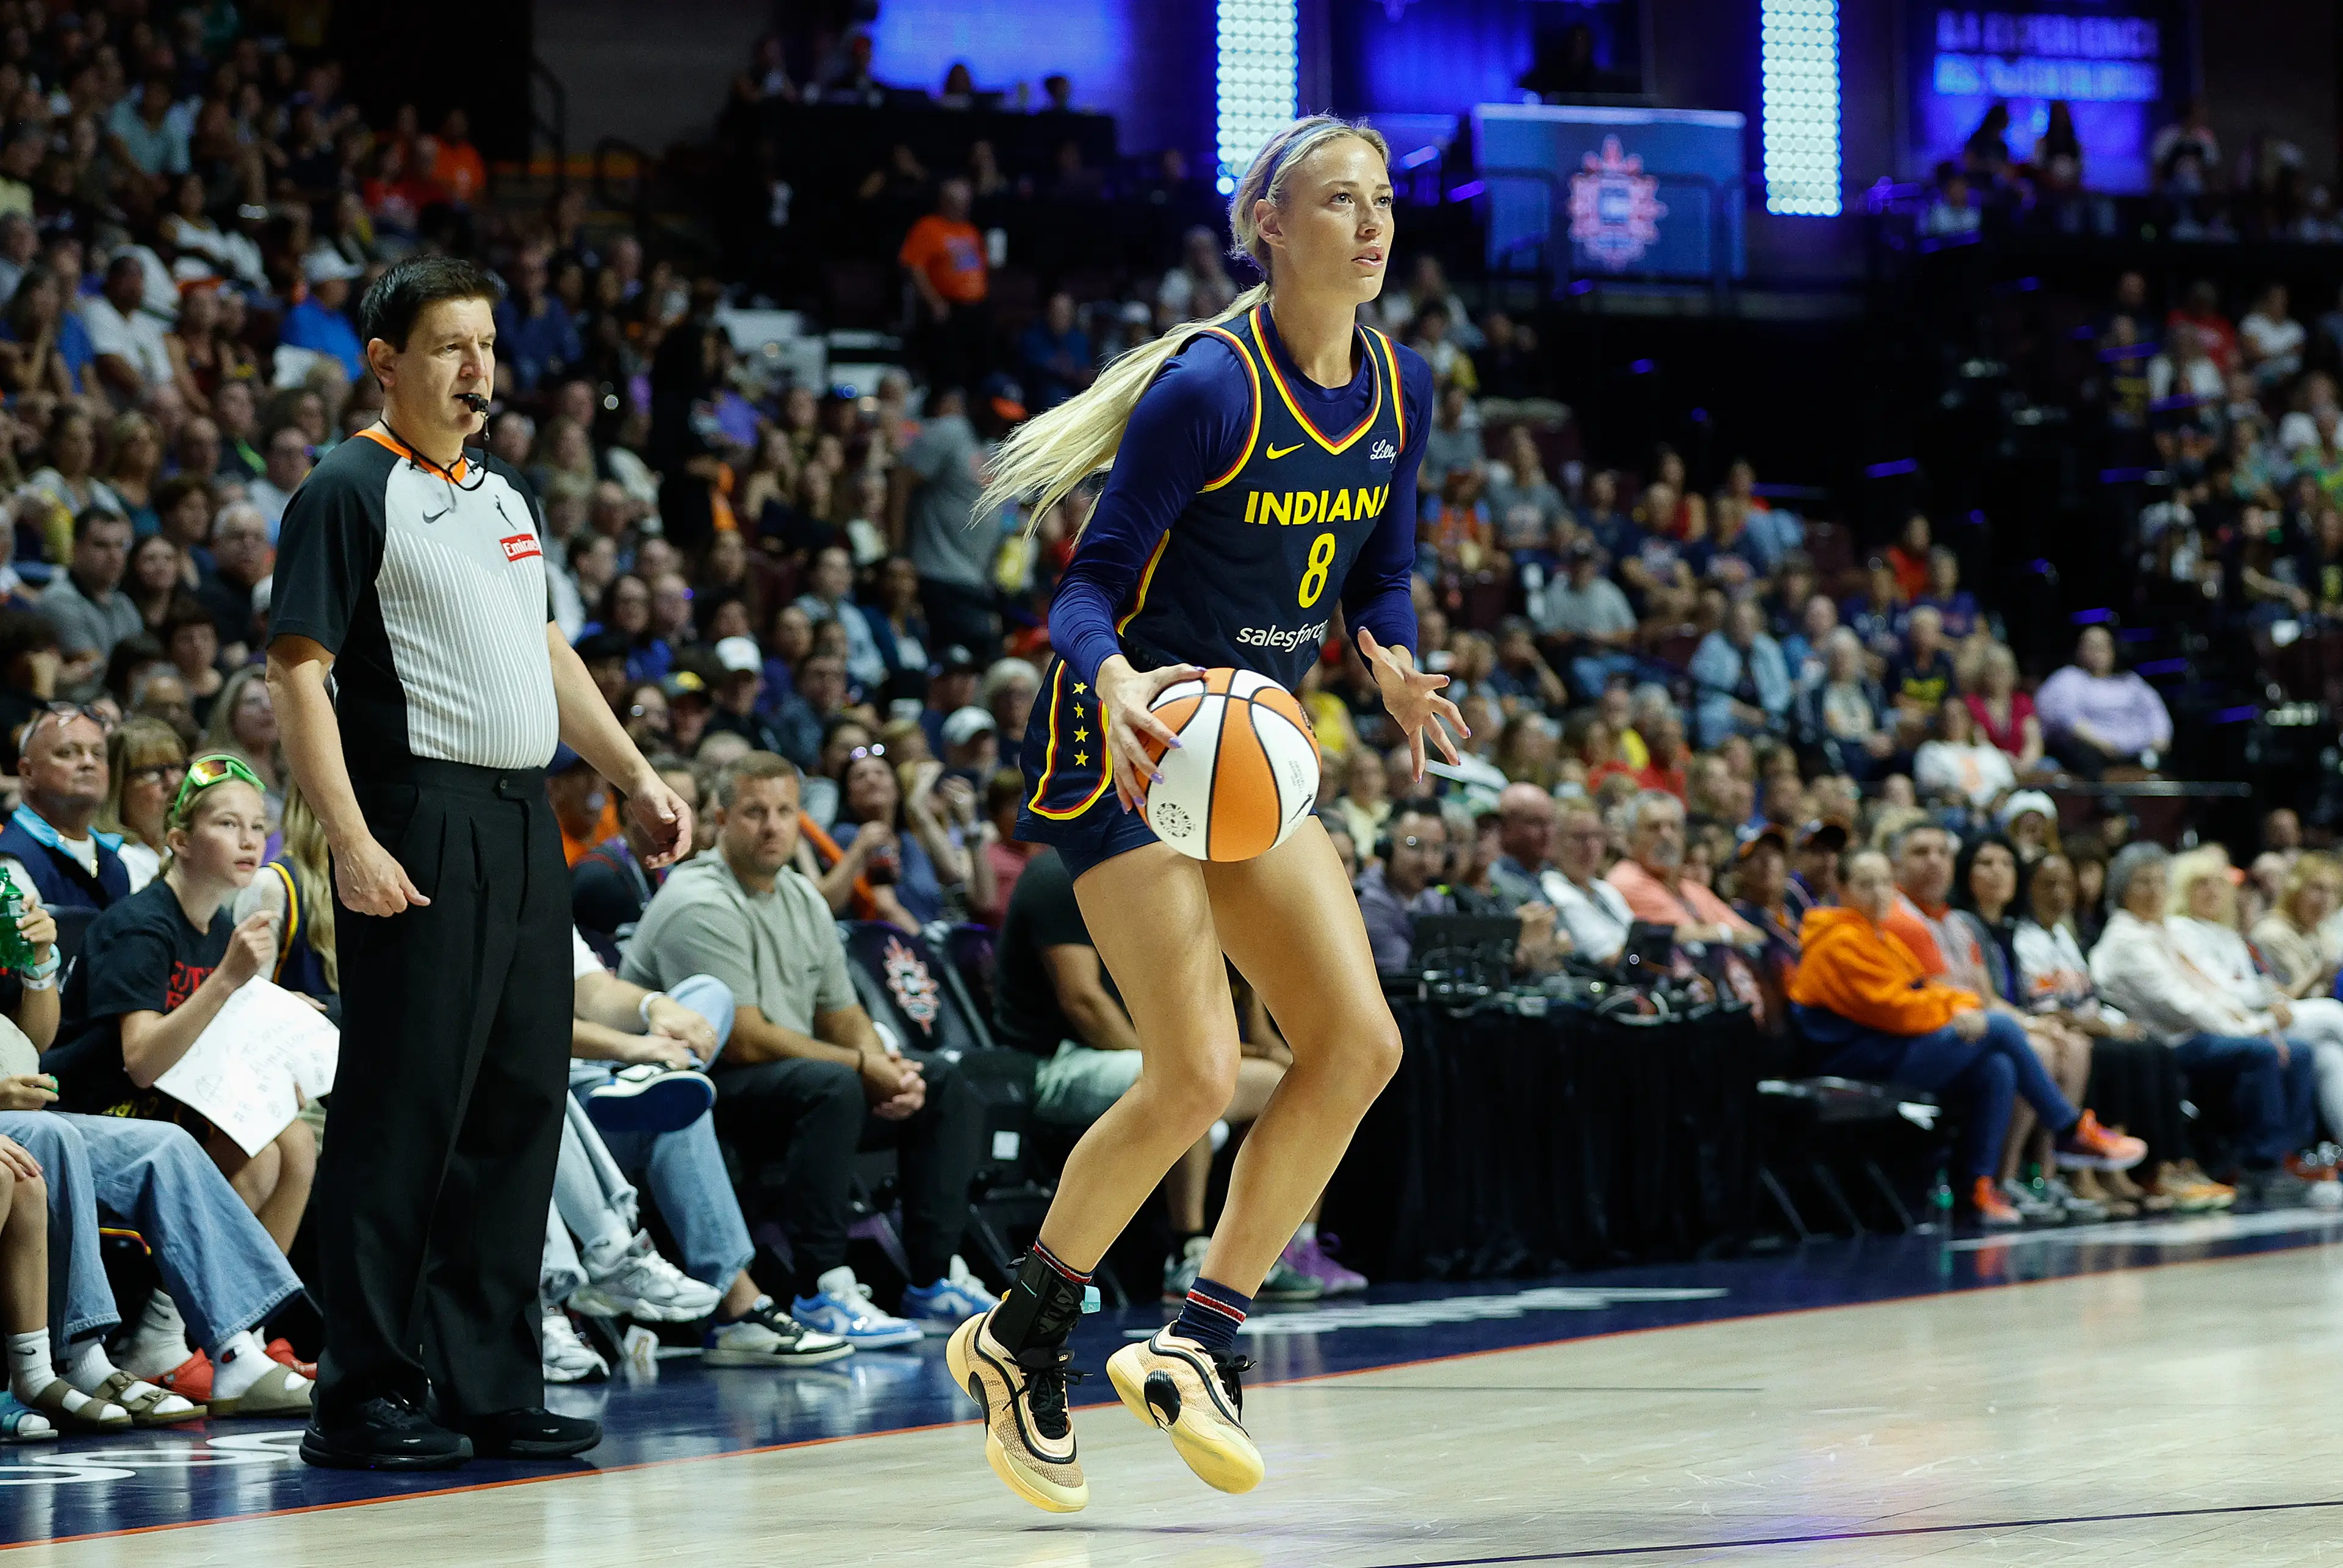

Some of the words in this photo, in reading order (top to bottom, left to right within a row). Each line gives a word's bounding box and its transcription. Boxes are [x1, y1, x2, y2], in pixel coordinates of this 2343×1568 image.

[1370, 439, 1397, 464] Lilly
[503, 539, 540, 556] Emir
[1298, 533, 1336, 608] 8
[1236, 619, 1328, 652] salesforc
